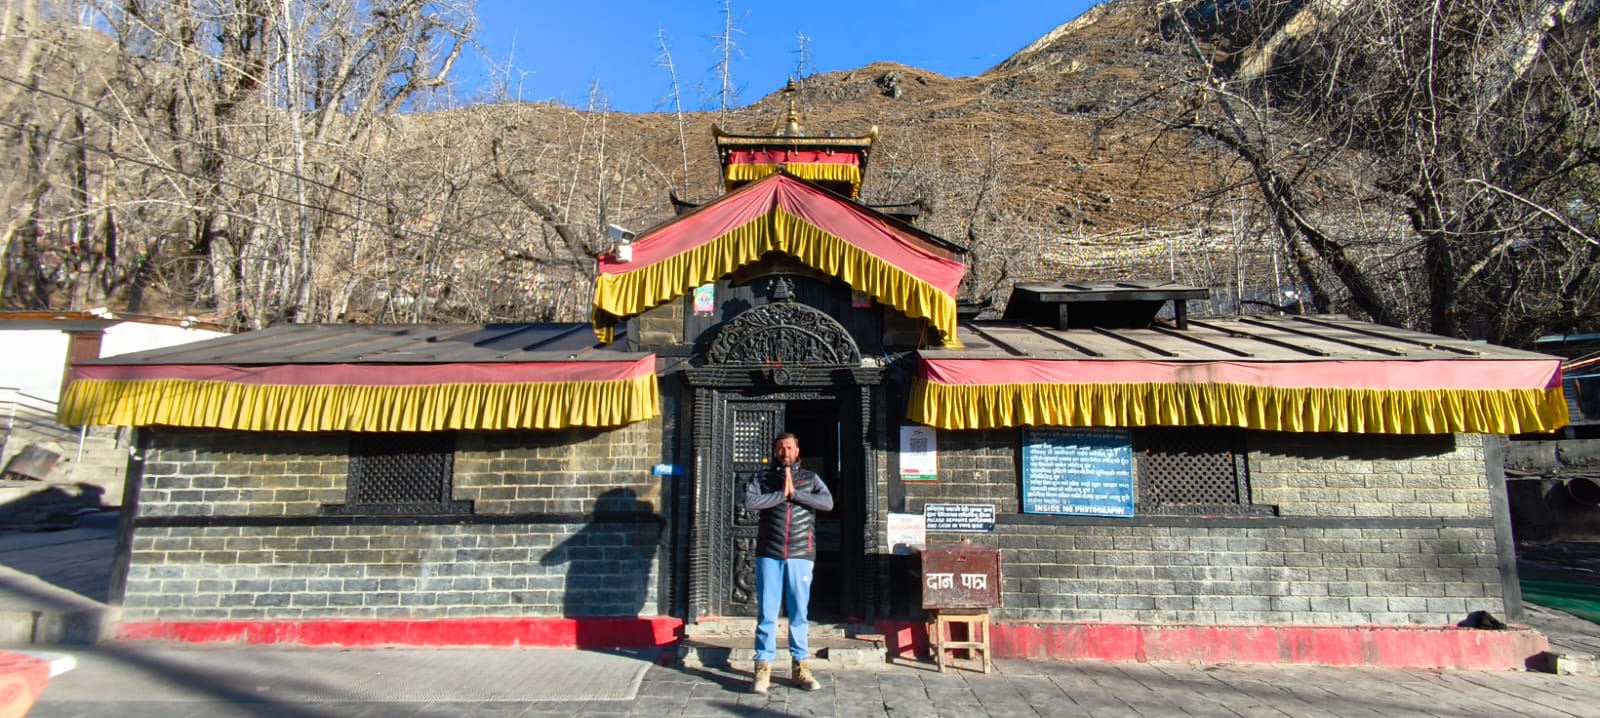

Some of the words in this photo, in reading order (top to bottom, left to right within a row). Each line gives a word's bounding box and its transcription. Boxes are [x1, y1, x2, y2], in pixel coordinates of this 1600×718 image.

[1034, 504, 1060, 513] INSIDE
[1062, 505, 1073, 513] NO
[1074, 505, 1125, 515] PHOTOGRAPHY
[926, 572, 954, 590] दान
[960, 572, 988, 590] पात्र
